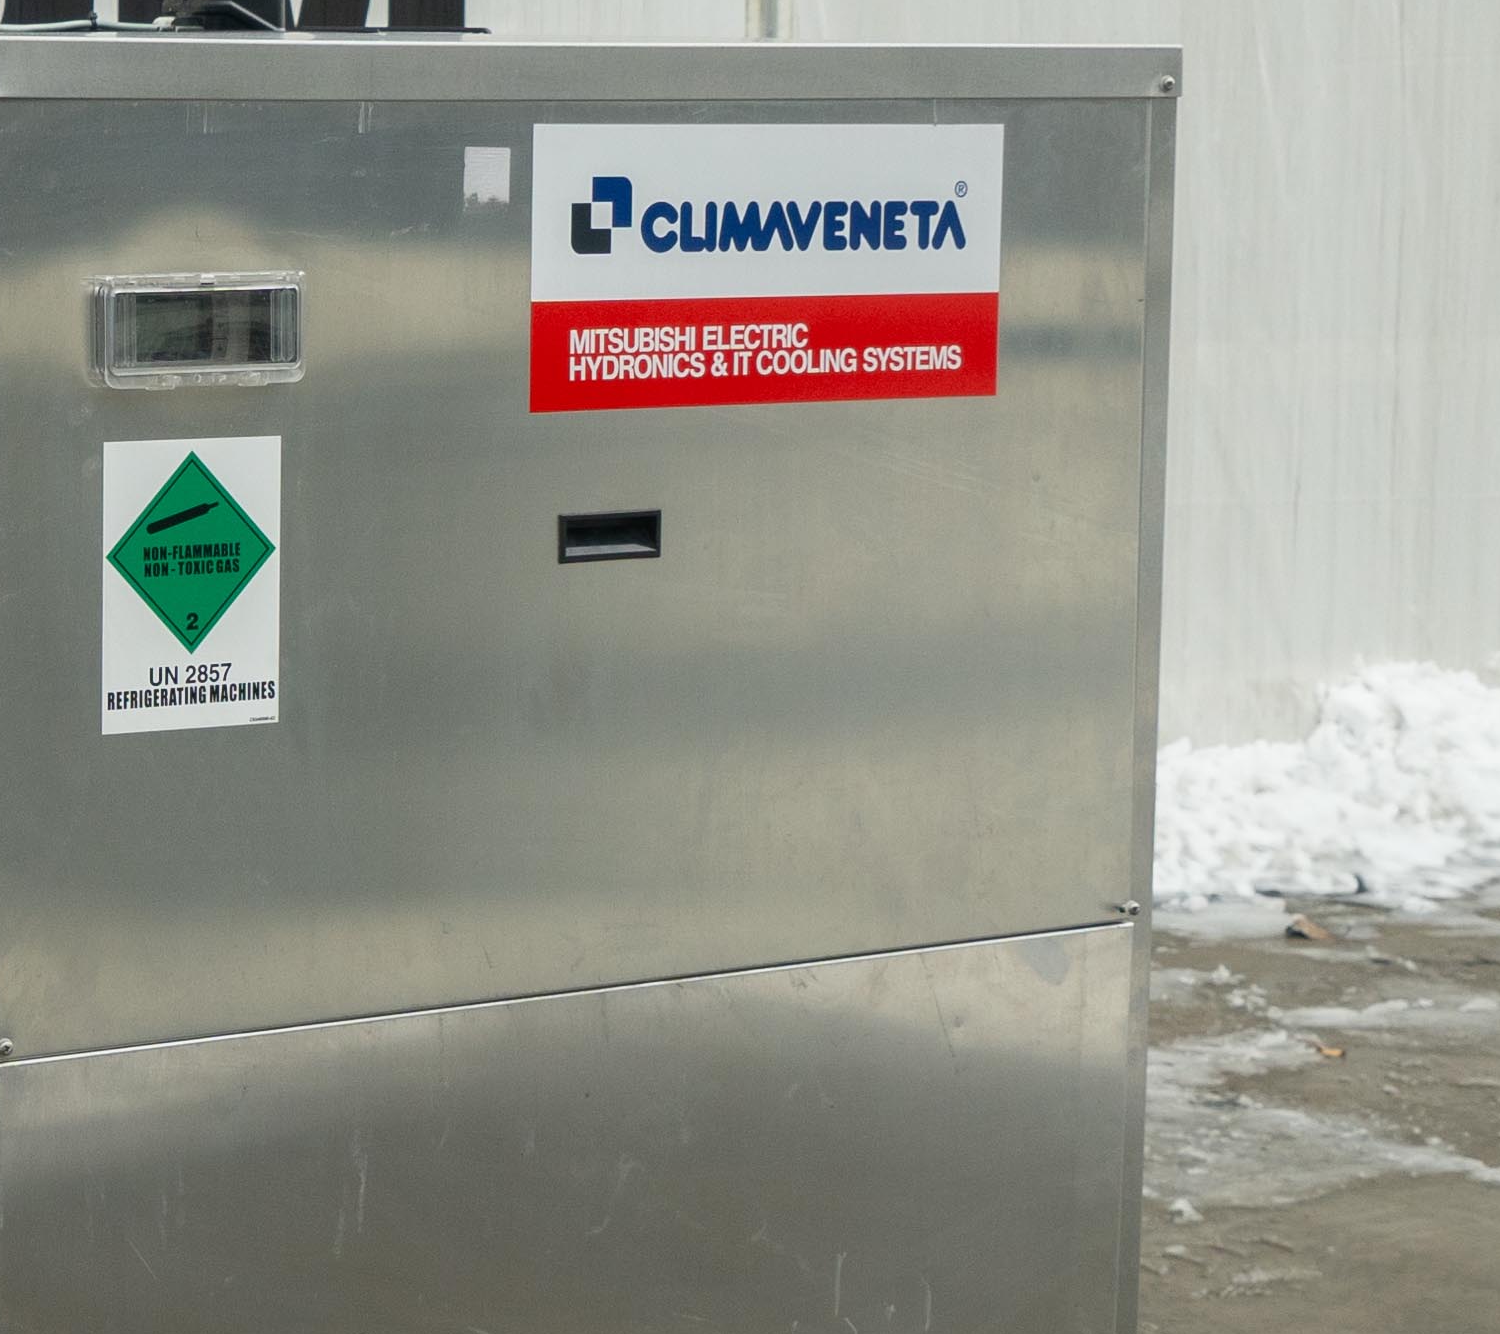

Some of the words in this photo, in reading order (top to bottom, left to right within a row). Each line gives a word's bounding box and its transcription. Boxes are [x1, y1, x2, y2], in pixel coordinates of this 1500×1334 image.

[640, 200, 967, 253] CLIMAVENETA
[569, 326, 696, 355] MITSUBISHI
[702, 322, 809, 351] ELECTRIC
[568, 353, 704, 381] HYDRONICS
[711, 352, 728, 376] &
[733, 351, 750, 376] IT
[756, 348, 857, 375] COOLING
[862, 344, 962, 372] SYSTEMS
[143, 542, 241, 561] NON-FLAMMABLE
[216, 558, 240, 574] GAS
[186, 612, 199, 631] 2
[149, 666, 179, 687] UN
[185, 663, 232, 684] 2857
[107, 685, 207, 711] REFRIGERATING
[209, 680, 276, 704] MACHINES
